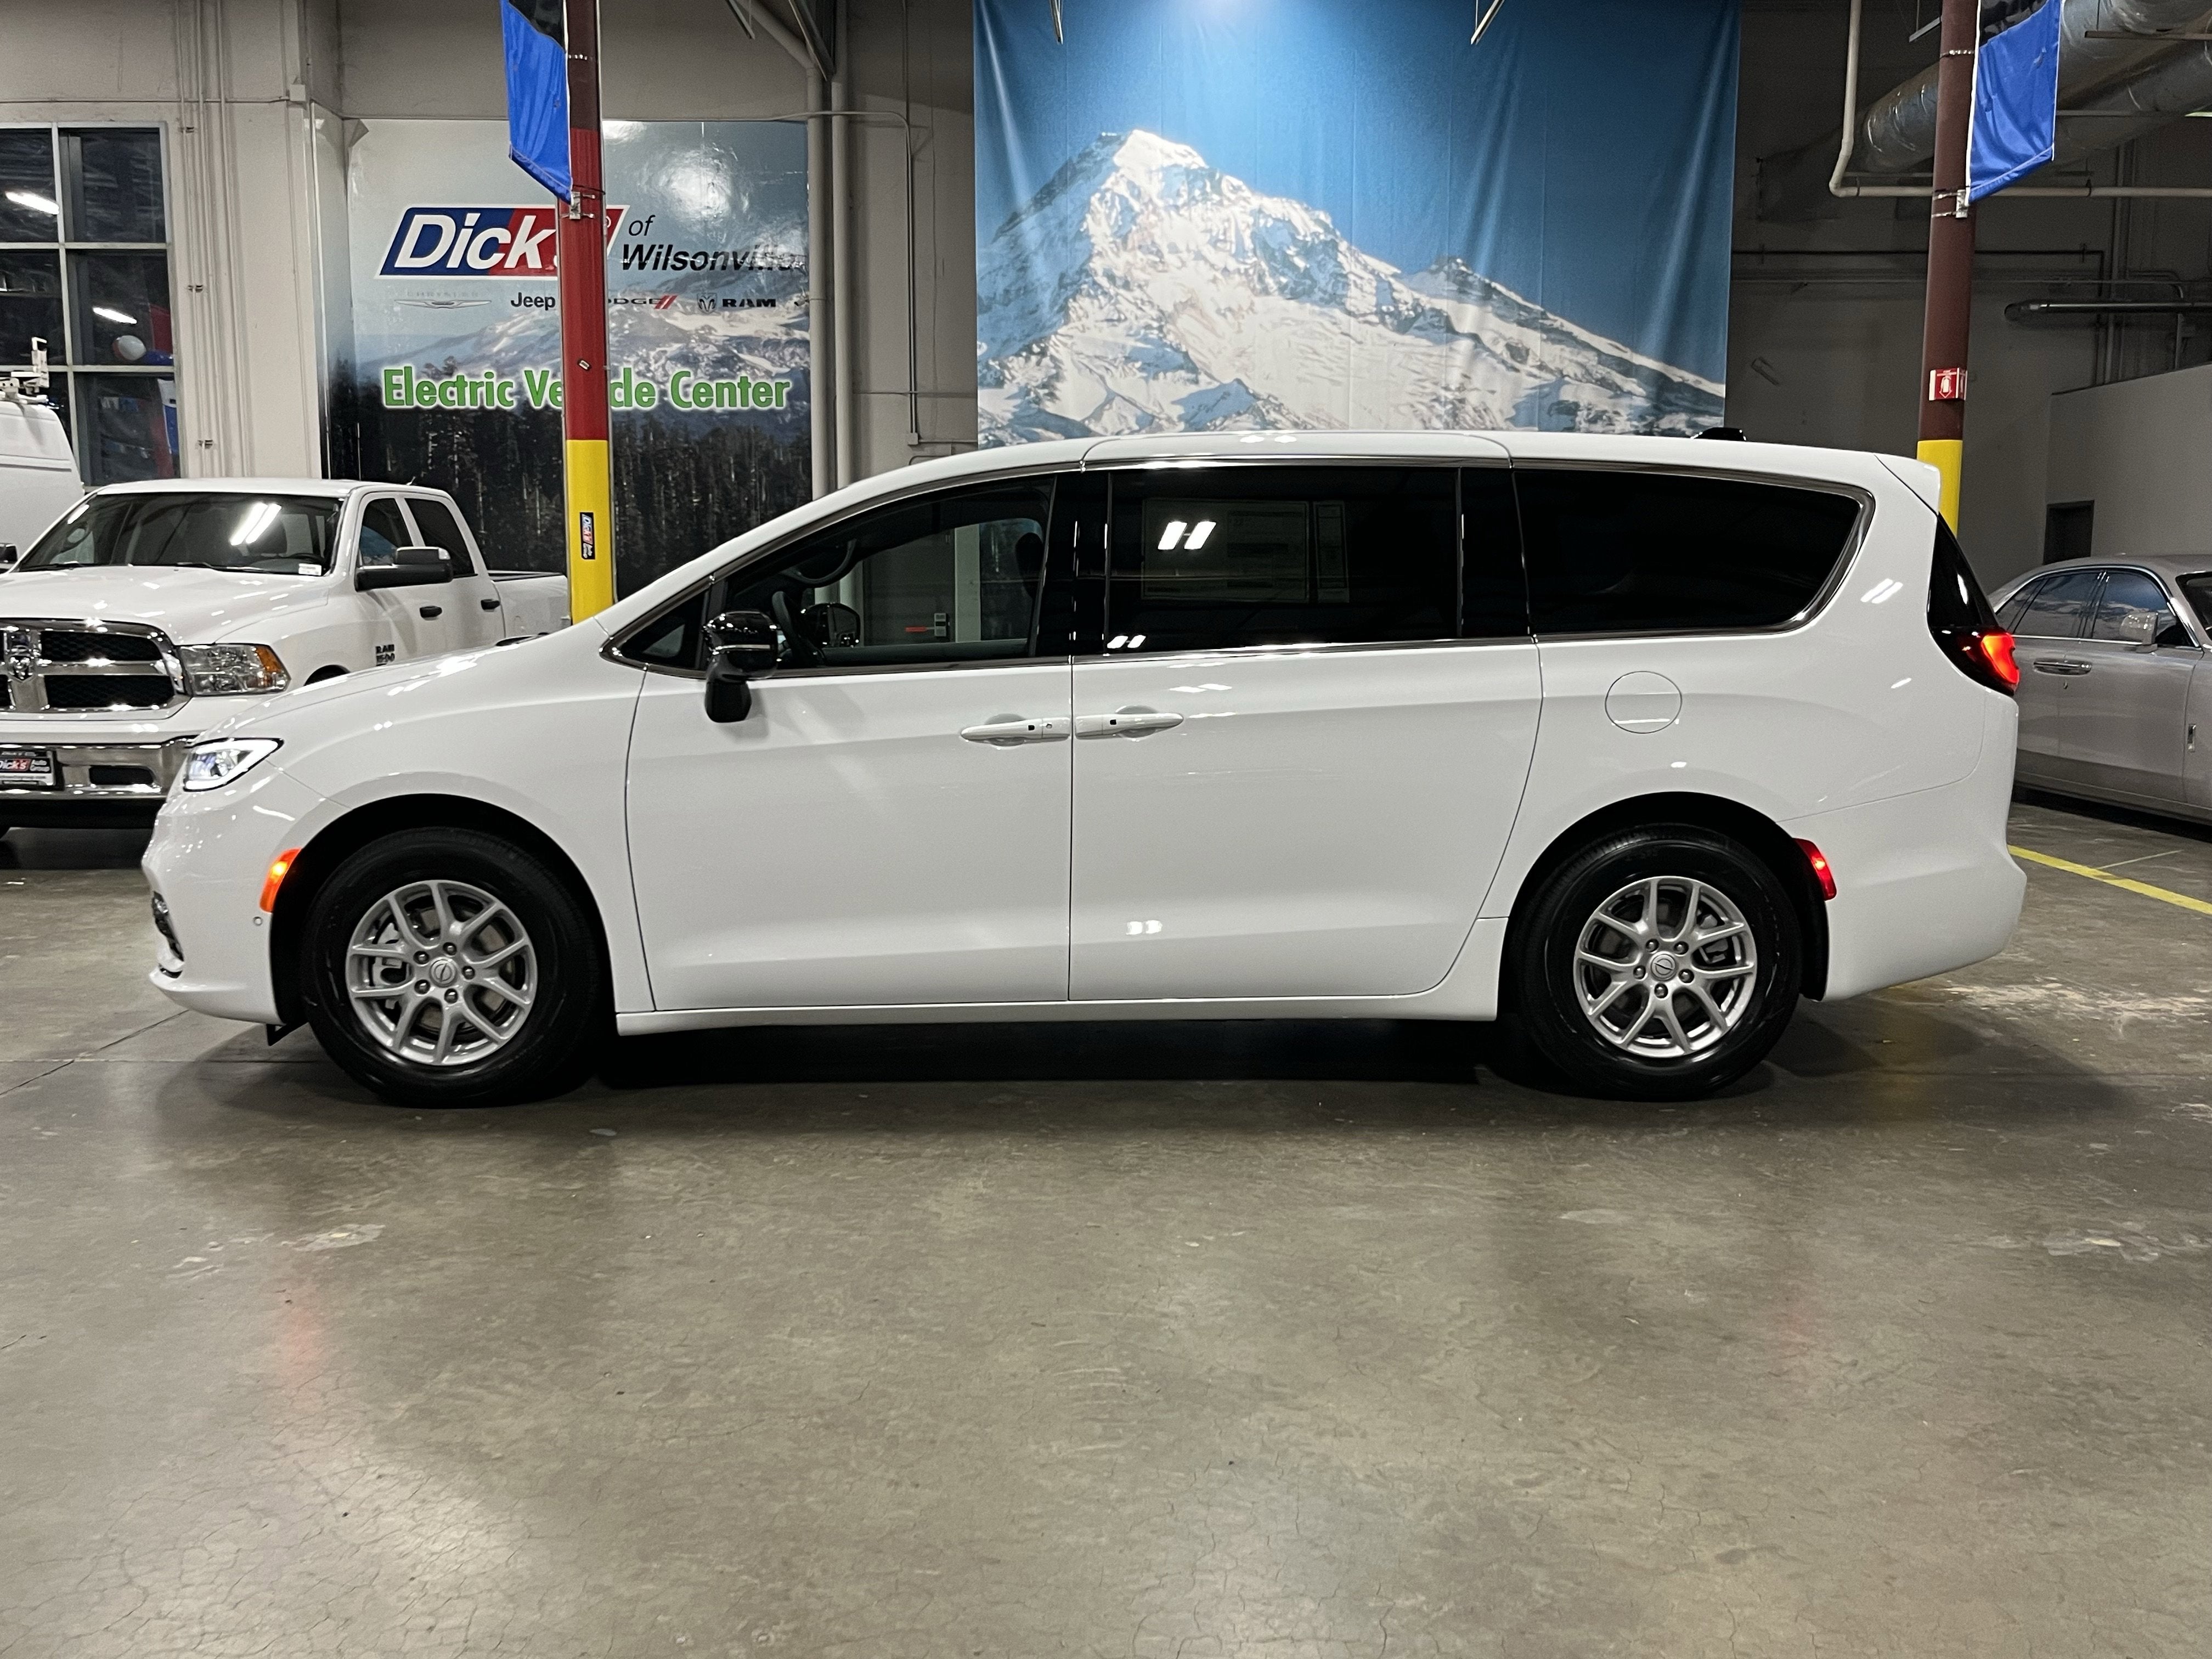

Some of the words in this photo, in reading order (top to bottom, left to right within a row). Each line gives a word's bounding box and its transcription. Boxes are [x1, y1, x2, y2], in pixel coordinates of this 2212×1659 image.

[628, 215, 656, 236] of
[394, 212, 557, 270] Dick
[623, 244, 792, 271] Wilsonvi
[511, 292, 556, 311] Jeep
[722, 298, 776, 308] RAM
[383, 366, 515, 408] Electric
[523, 368, 656, 408] Vecle
[670, 370, 791, 408] Center
